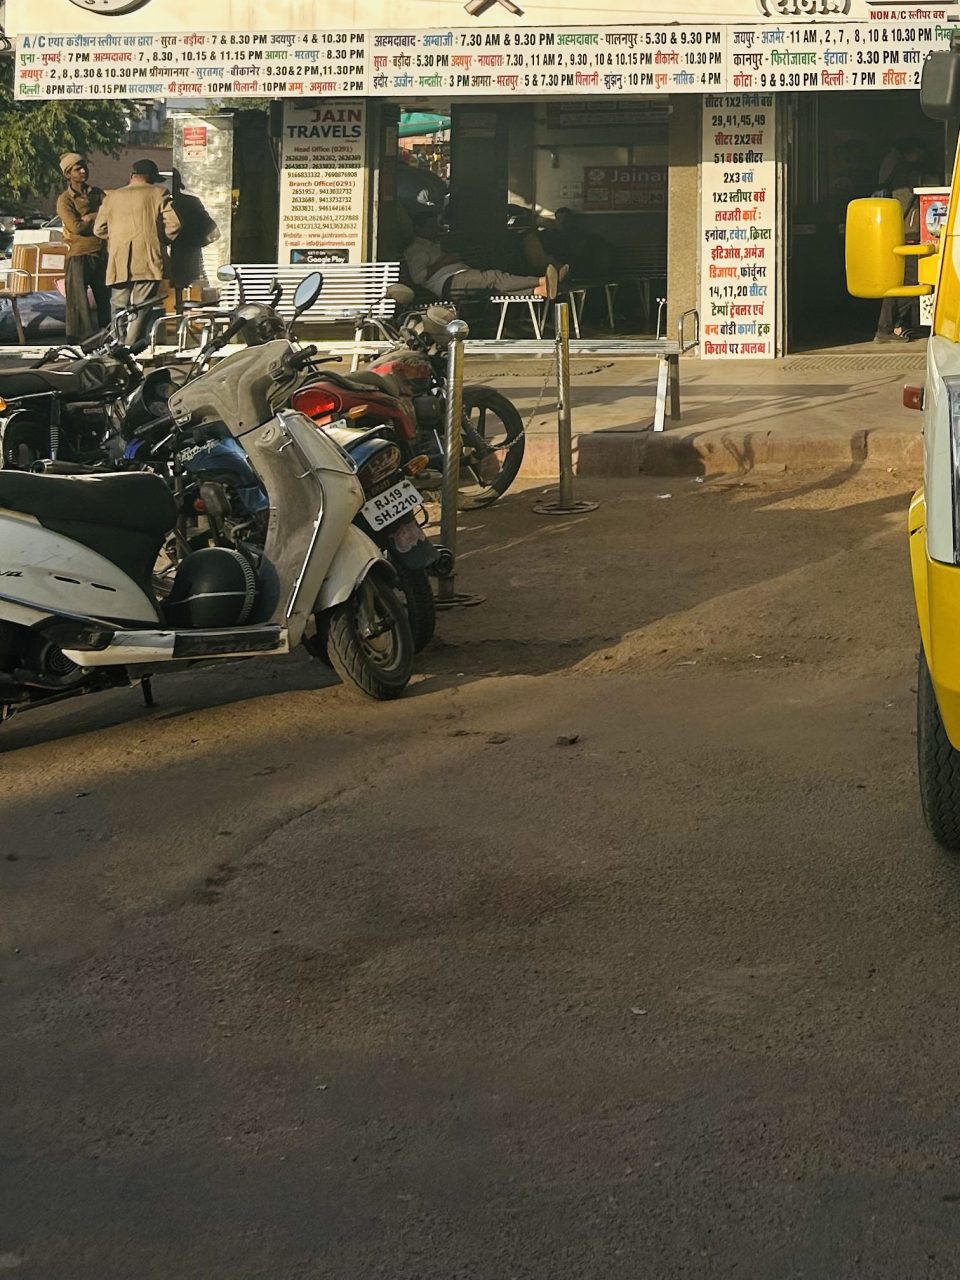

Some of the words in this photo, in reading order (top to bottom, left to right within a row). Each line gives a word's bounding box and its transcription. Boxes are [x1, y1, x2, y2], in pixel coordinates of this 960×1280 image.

[870, 10, 889, 20] NON
[890, 10, 907, 20] A/C
[908, 8, 931, 20] स्लीपर
[23, 35, 46, 48] A/C
[212, 35, 217, 44] 7
[220, 35, 227, 45] &
[230, 35, 250, 45] 8.30
[253, 35, 267, 44] PM
[270, 34, 296, 47] उदयपुर
[302, 34, 309, 44] 4
[311, 34, 318, 44] &
[321, 34, 347, 44] 10.30
[350, 33, 365, 43] PM
[374, 35, 416, 47] अहमदाबाद
[460, 34, 482, 46] 7.30
[485, 34, 501, 46] AM
[503, 34, 511, 46] &
[514, 34, 536, 46] 9.30
[539, 33, 555, 45] PM
[556, 33, 599, 46] अहमदाबाद
[605, 33, 638, 48] पालनपुर
[645, 32, 667, 45] 5.30
[670, 32, 677, 45] &
[680, 32, 702, 44] 9.30
[705, 31, 721, 44] PM
[733, 31, 755, 48] जयपुर
[761, 27, 785, 44] अजमेर
[803, 30, 817, 43] AM
[825, 30, 831, 43] 2
[839, 29, 844, 42] 7
[854, 29, 860, 42] 8
[868, 29, 879, 42] 10
[881, 29, 889, 42] &
[891, 28, 915, 41] 10.30
[918, 28, 932, 41] PM
[68, 53, 74, 63] 7
[76, 52, 90, 62] PM
[138, 52, 144, 62] 7
[152, 52, 172, 62] 8.30
[182, 51, 207, 61] 10.15
[209, 51, 217, 61] &
[220, 51, 246, 60] 11.15
[248, 50, 263, 60] PM
[265, 50, 288, 60] आगरा
[327, 49, 347, 60] 8.30
[350, 49, 364, 59] PM
[733, 53, 763, 70] कानपुर
[771, 49, 817, 66] फिरोजाबाद
[823, 47, 848, 66] ईटावा
[857, 51, 879, 64] 3.30
[882, 50, 899, 64] PM
[733, 71, 753, 87] कोटा
[760, 73, 767, 87] 9
[769, 73, 777, 86] &
[779, 73, 800, 86] 9.30
[803, 73, 818, 86] PM
[821, 70, 845, 86] दिल्ली
[852, 72, 858, 85] 7
[861, 72, 876, 85] PM
[882, 68, 907, 86] हरिद्वार
[725, 97, 740, 108] 1X2
[311, 109, 362, 123] JAIN
[712, 115, 766, 128] 29,41,45,49
[287, 125, 362, 138] TRAVELS
[714, 132, 733, 145] सीटर
[734, 134, 751, 145] 2X2
[714, 152, 725, 163] 51
[733, 152, 743, 163] 66
[745, 150, 763, 163] सीटर
[724, 172, 740, 183] 2X3
[712, 192, 728, 203] 1X2
[729, 189, 753, 203] स्लीपर
[307, 256, 331, 264] Google
[709, 285, 748, 299] 14,17,20
[749, 283, 768, 297] सीटर
[729, 343, 739, 354] पर
[374, 489, 403, 510] RJ.19
[374, 494, 418, 525] SH.2210
